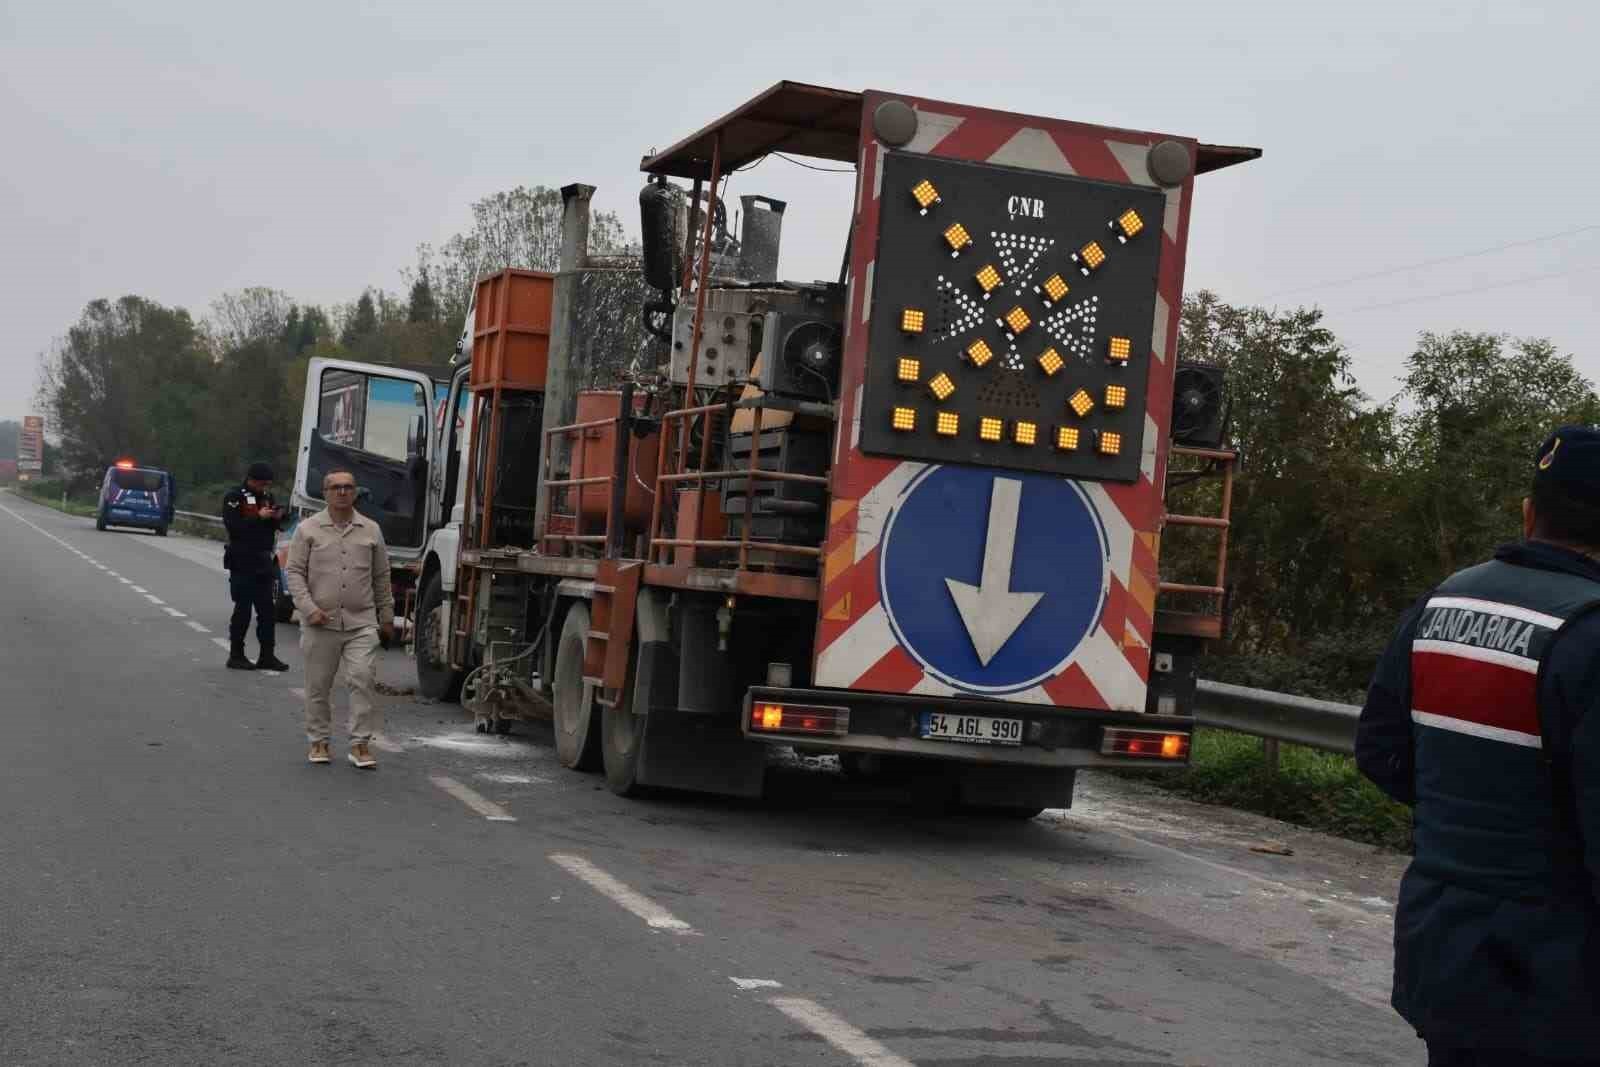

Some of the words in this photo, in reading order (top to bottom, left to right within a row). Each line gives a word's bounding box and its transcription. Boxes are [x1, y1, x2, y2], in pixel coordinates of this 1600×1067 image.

[1008, 195, 1044, 221] ÇNR
[1422, 607, 1535, 657] JANDARMA
[930, 715, 948, 734] 54
[956, 717, 983, 737] AGL
[991, 720, 1019, 738] 990
